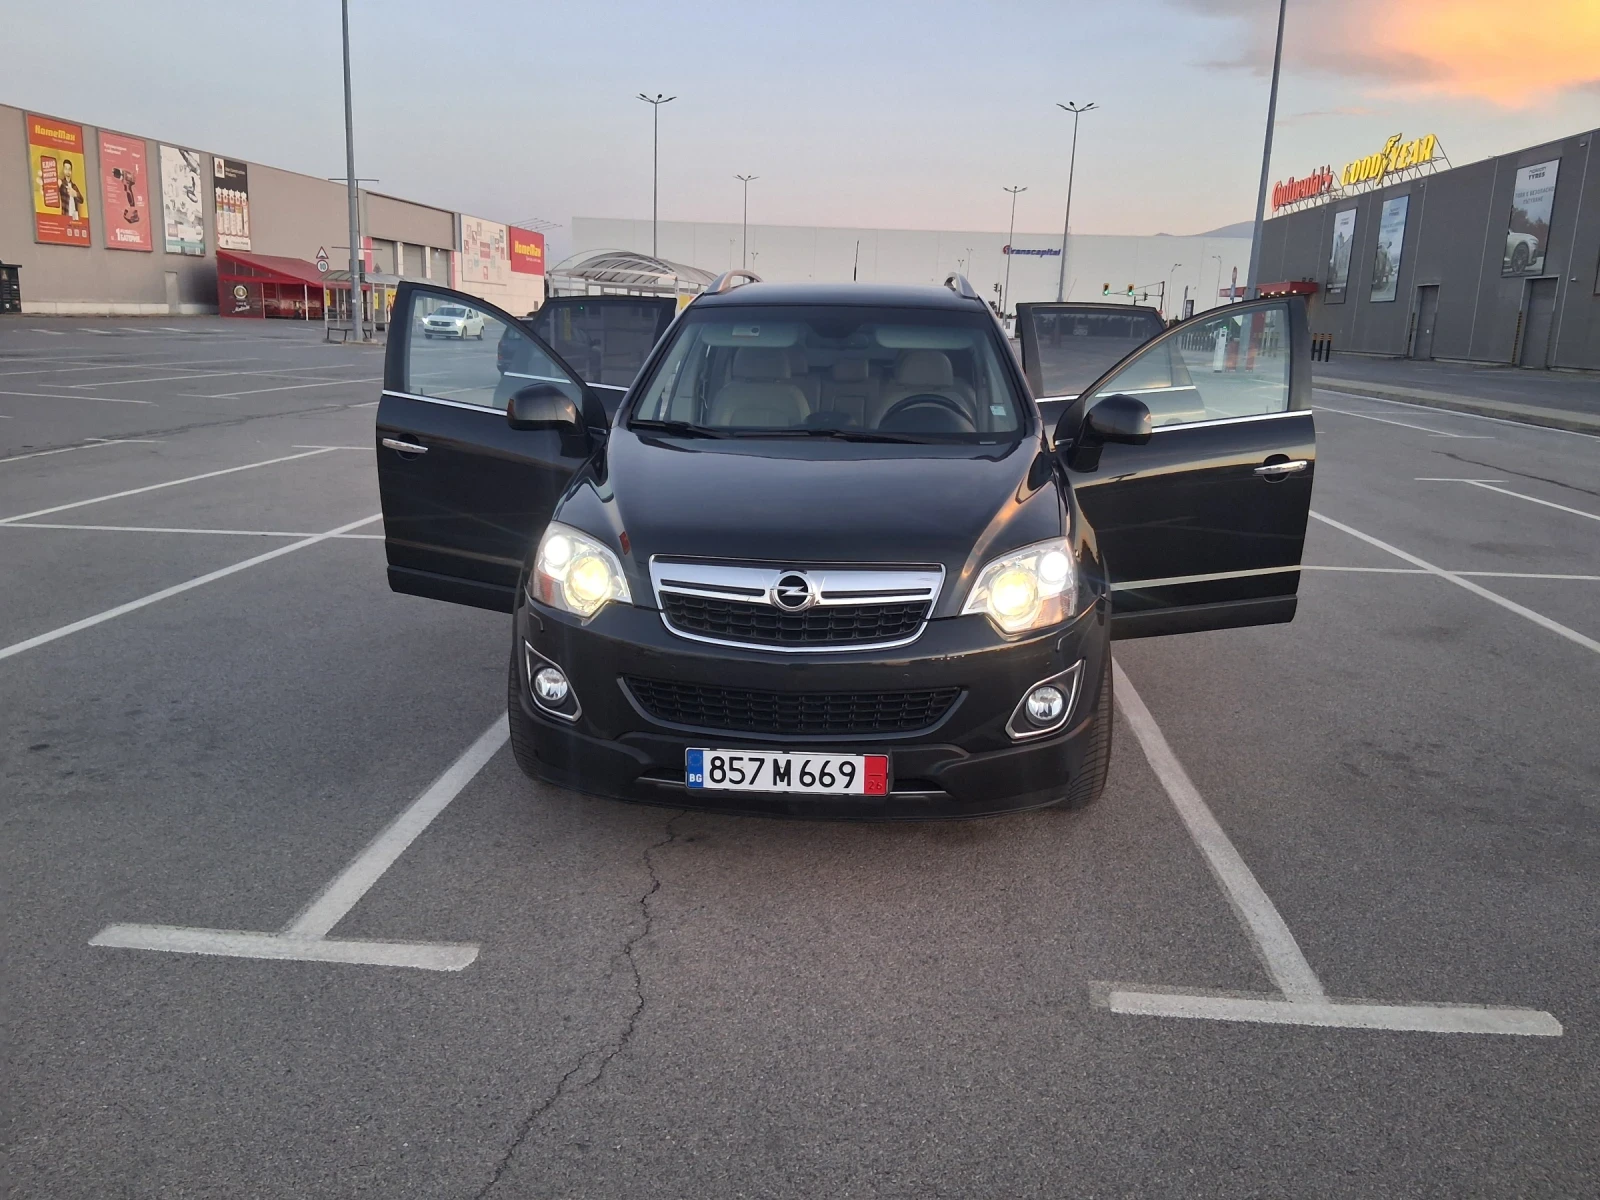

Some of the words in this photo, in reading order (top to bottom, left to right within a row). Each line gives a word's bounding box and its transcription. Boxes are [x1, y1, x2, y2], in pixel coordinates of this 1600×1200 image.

[35, 124, 76, 142] HomeMax
[1341, 133, 1436, 187] GOODYEAR
[1272, 166, 1325, 211] Continental
[690, 773, 703, 783] BG
[709, 756, 765, 785] 857
[772, 759, 791, 787] M
[799, 759, 856, 789] 669
